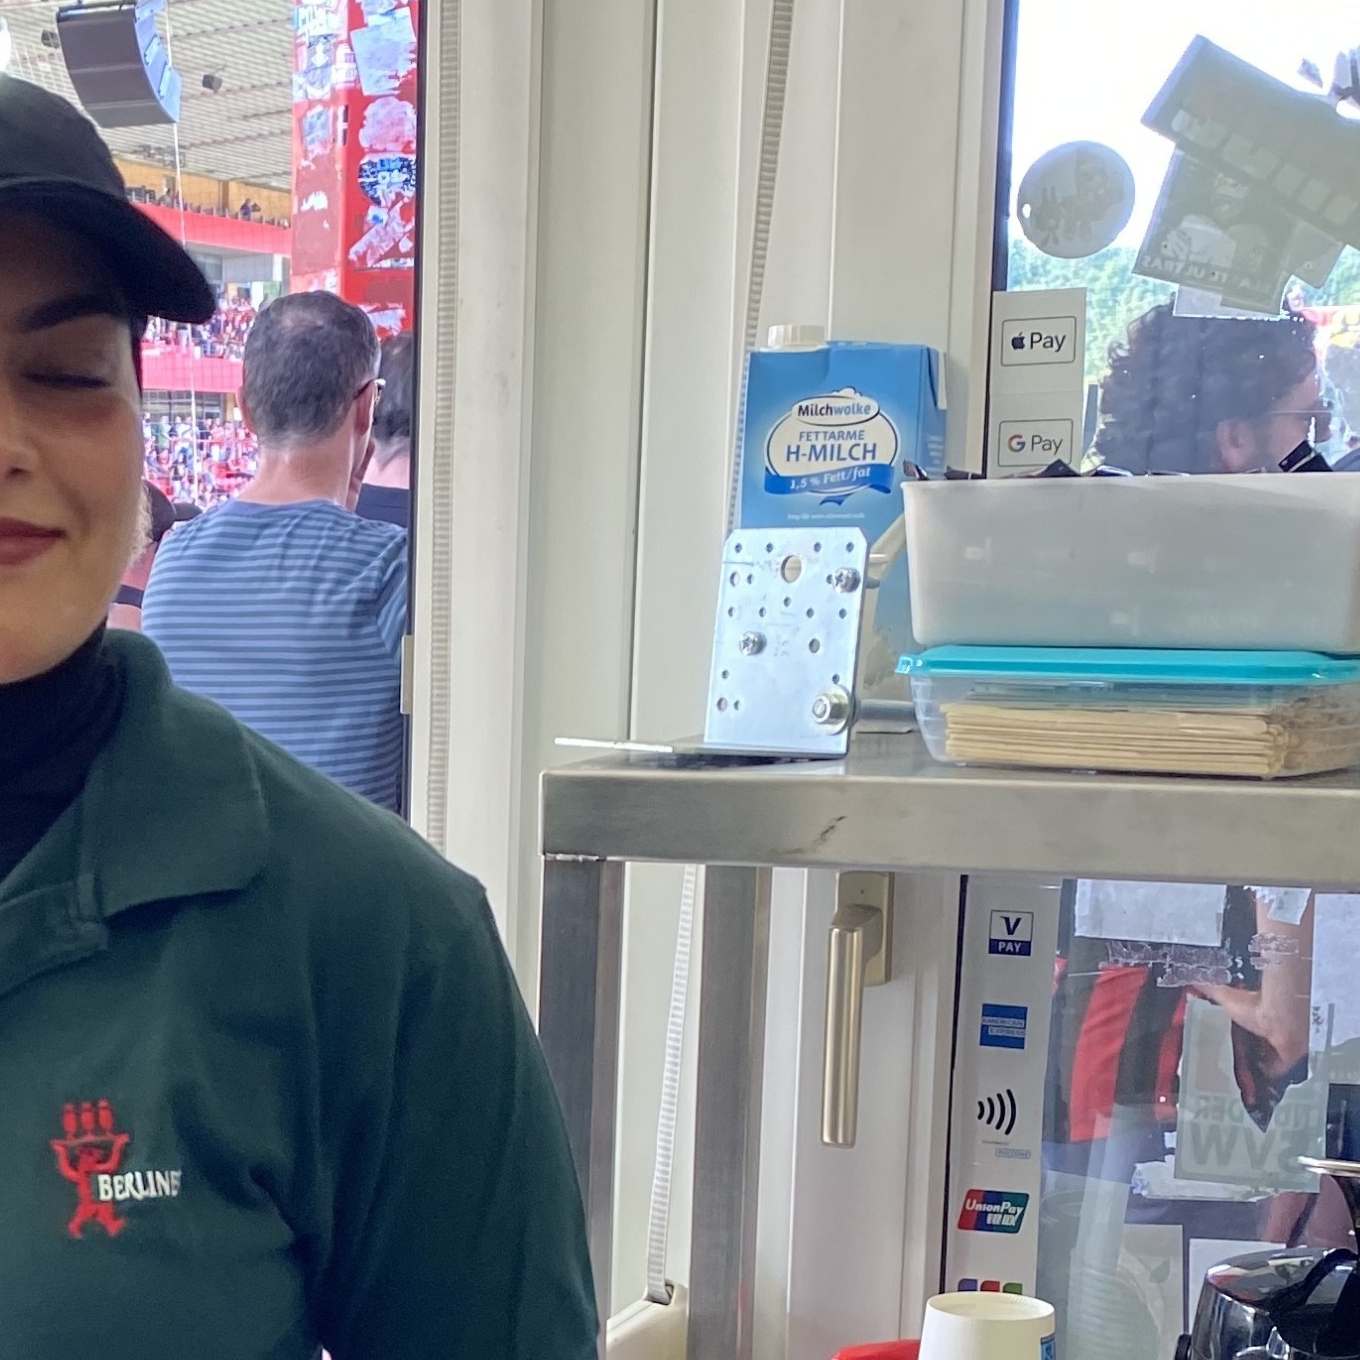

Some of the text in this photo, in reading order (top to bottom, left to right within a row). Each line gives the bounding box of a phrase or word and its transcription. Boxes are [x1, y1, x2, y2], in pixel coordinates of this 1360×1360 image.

[1029, 331, 1067, 353] Pay
[797, 403, 872, 417] Milchwolke
[798, 429, 866, 442] FETTARME
[1031, 434, 1064, 456] Pay
[786, 443, 877, 462] H-MILCH
[789, 466, 872, 490] 1,5 % Fett/fat
[999, 915, 1022, 936] V
[998, 941, 1022, 953] PAY
[965, 1198, 1025, 1220] UnionPay
